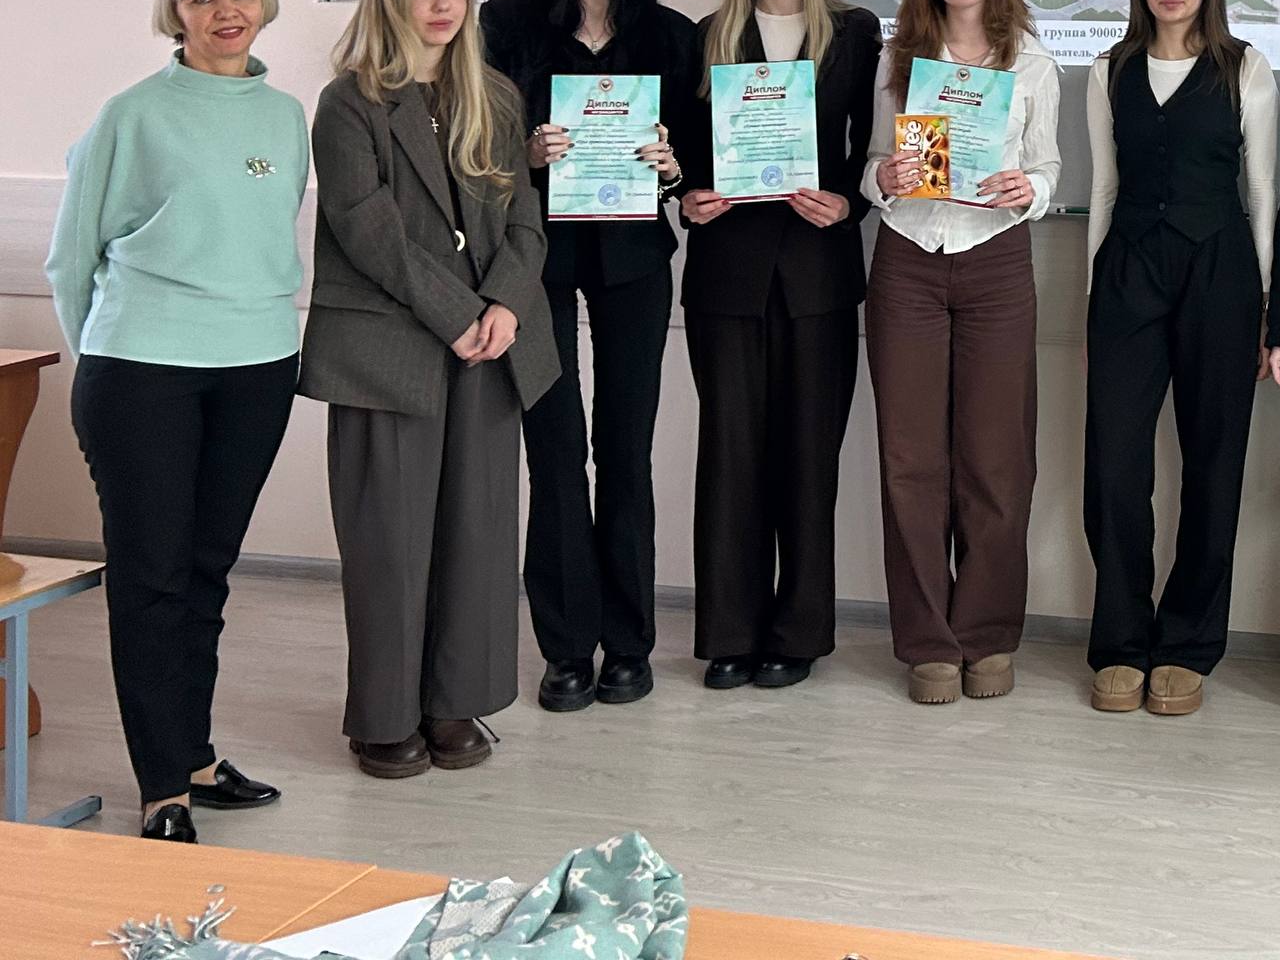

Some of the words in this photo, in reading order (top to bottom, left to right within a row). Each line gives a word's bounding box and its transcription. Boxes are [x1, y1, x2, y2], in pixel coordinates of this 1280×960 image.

[1044, 27, 1087, 41] группа
[744, 84, 787, 95] Диплом
[941, 85, 984, 100] Диплом
[585, 99, 630, 109] Диплом
